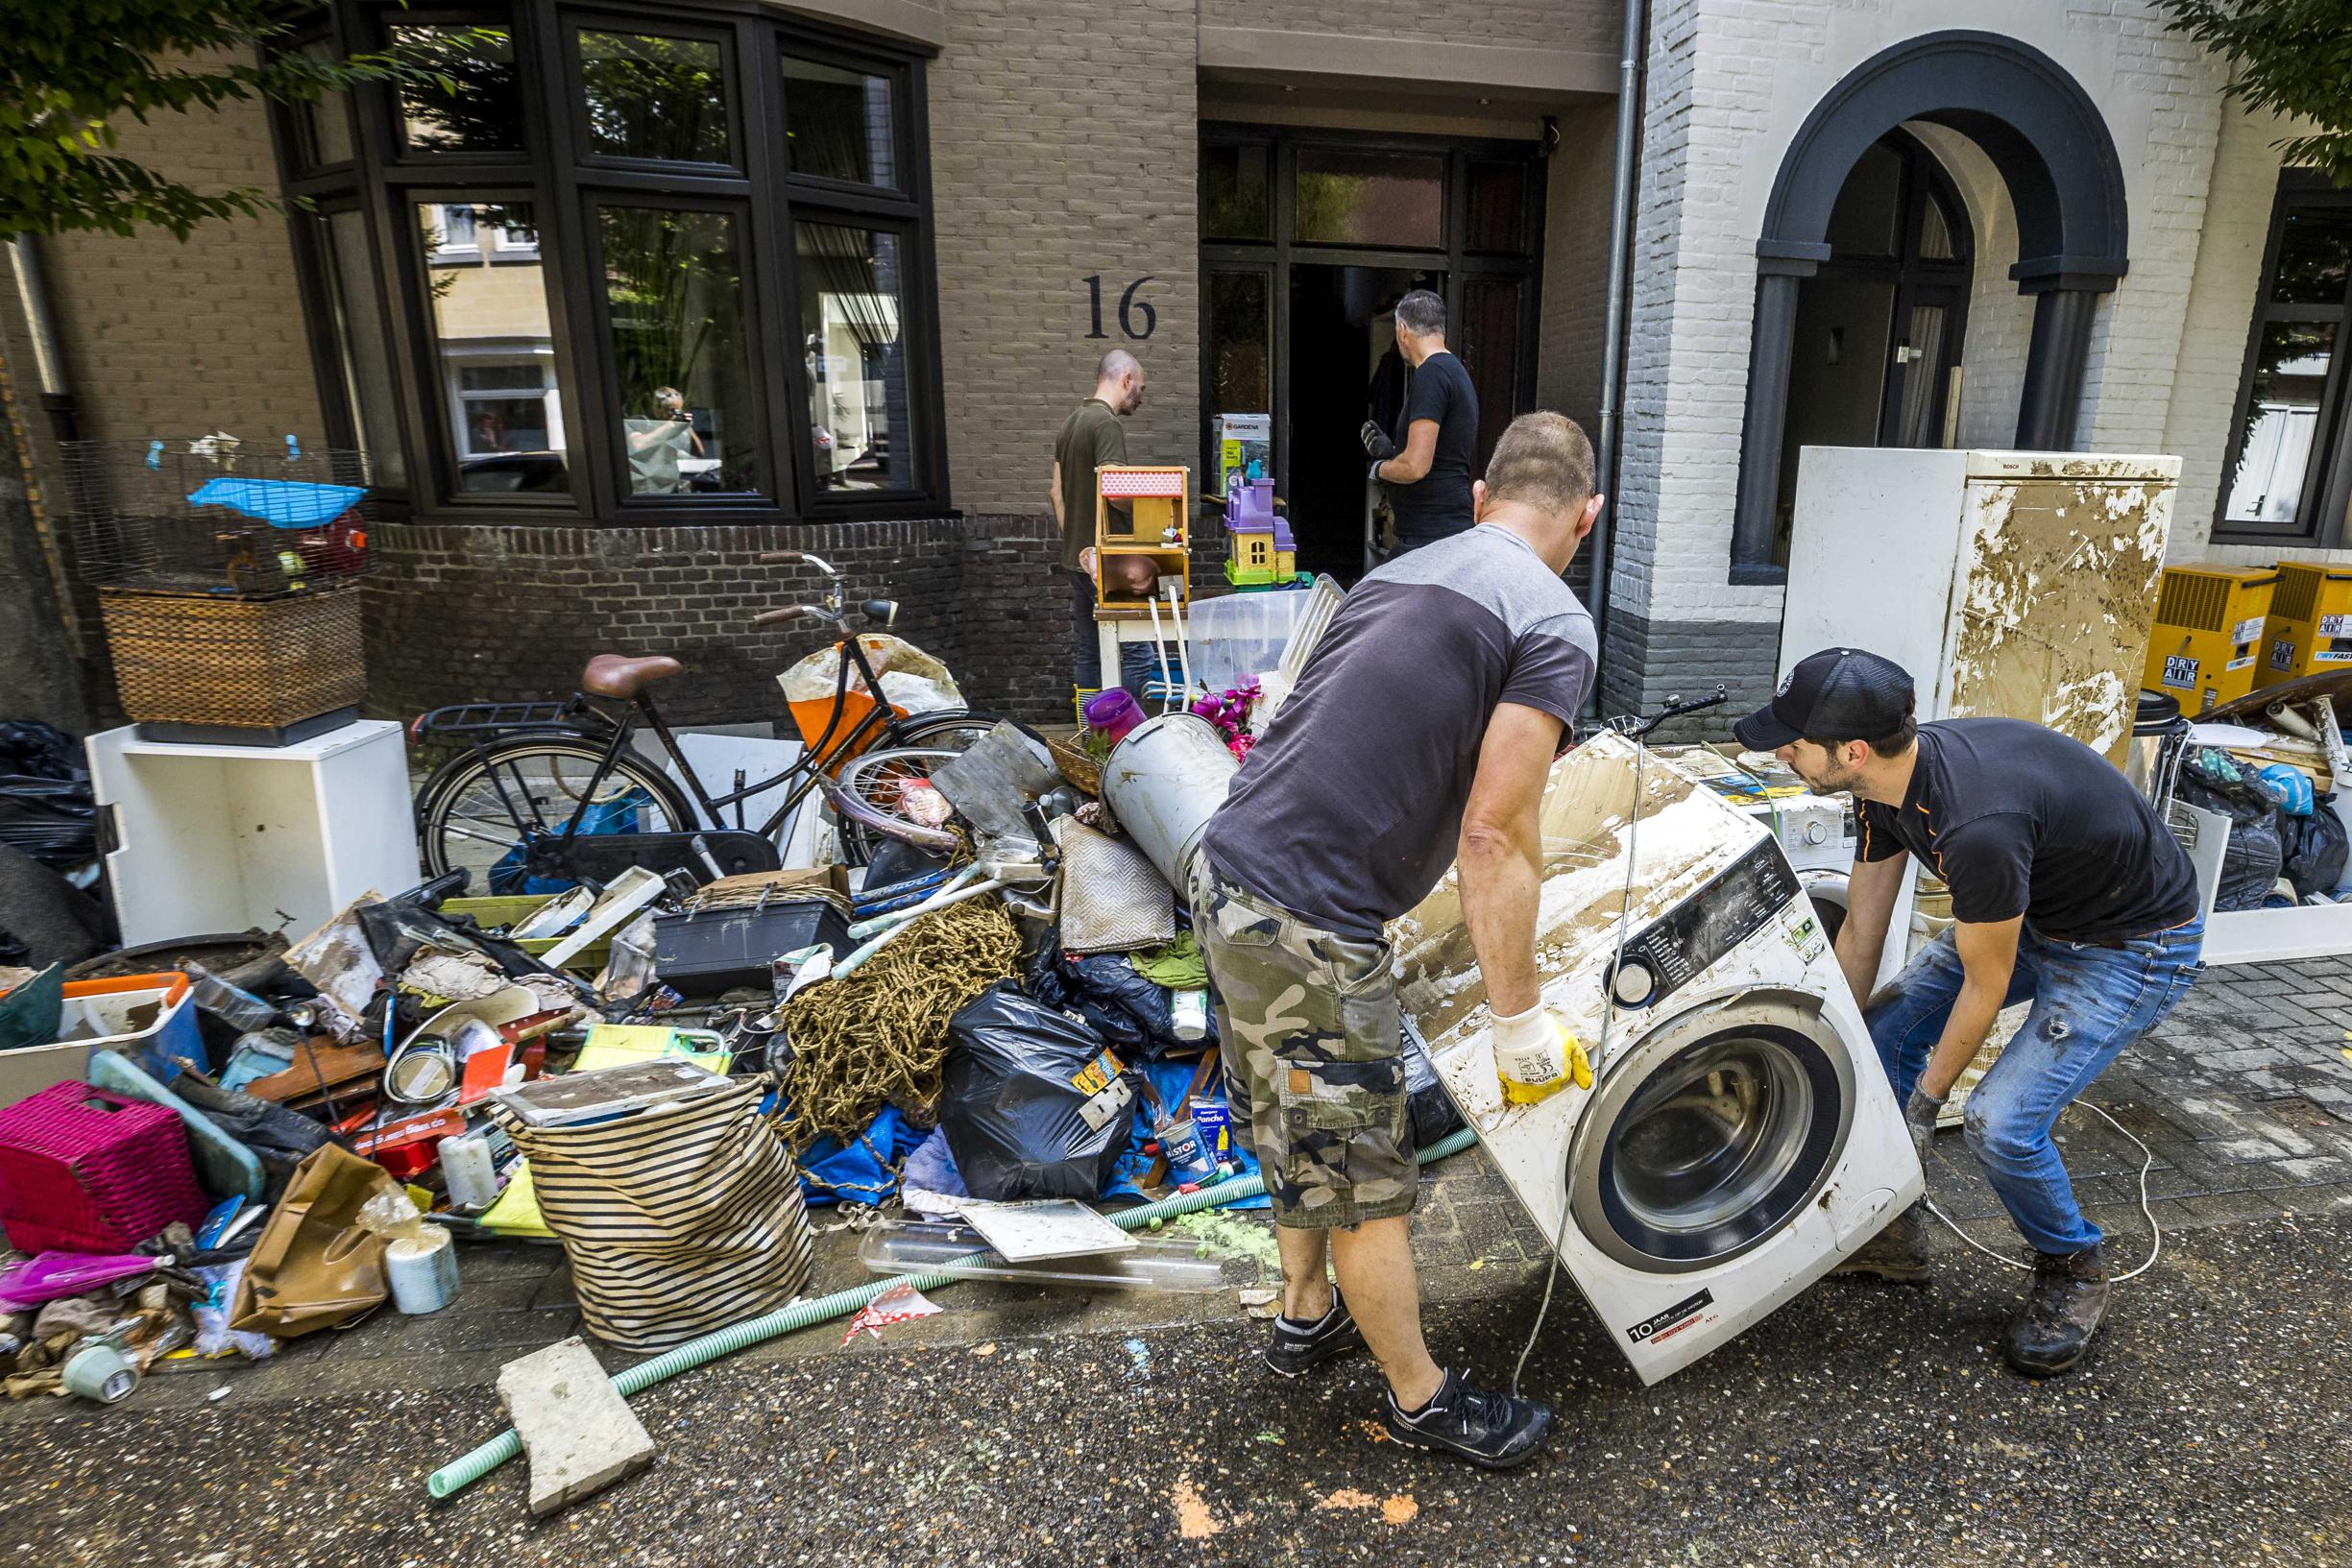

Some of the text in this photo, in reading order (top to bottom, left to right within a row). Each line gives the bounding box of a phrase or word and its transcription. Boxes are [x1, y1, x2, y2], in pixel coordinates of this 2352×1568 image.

[1081, 275, 1156, 340] 16
[2320, 615, 2343, 624] DRY
[2319, 624, 2341, 633] AIR
[2273, 640, 2295, 654] DRY
[2167, 655, 2199, 670] DRY
[2270, 652, 2292, 664] AIR
[2164, 669, 2196, 683] AIR
[1165, 1140, 1197, 1159] HISTOR
[1629, 1313, 1670, 1340] 10 JAAR
